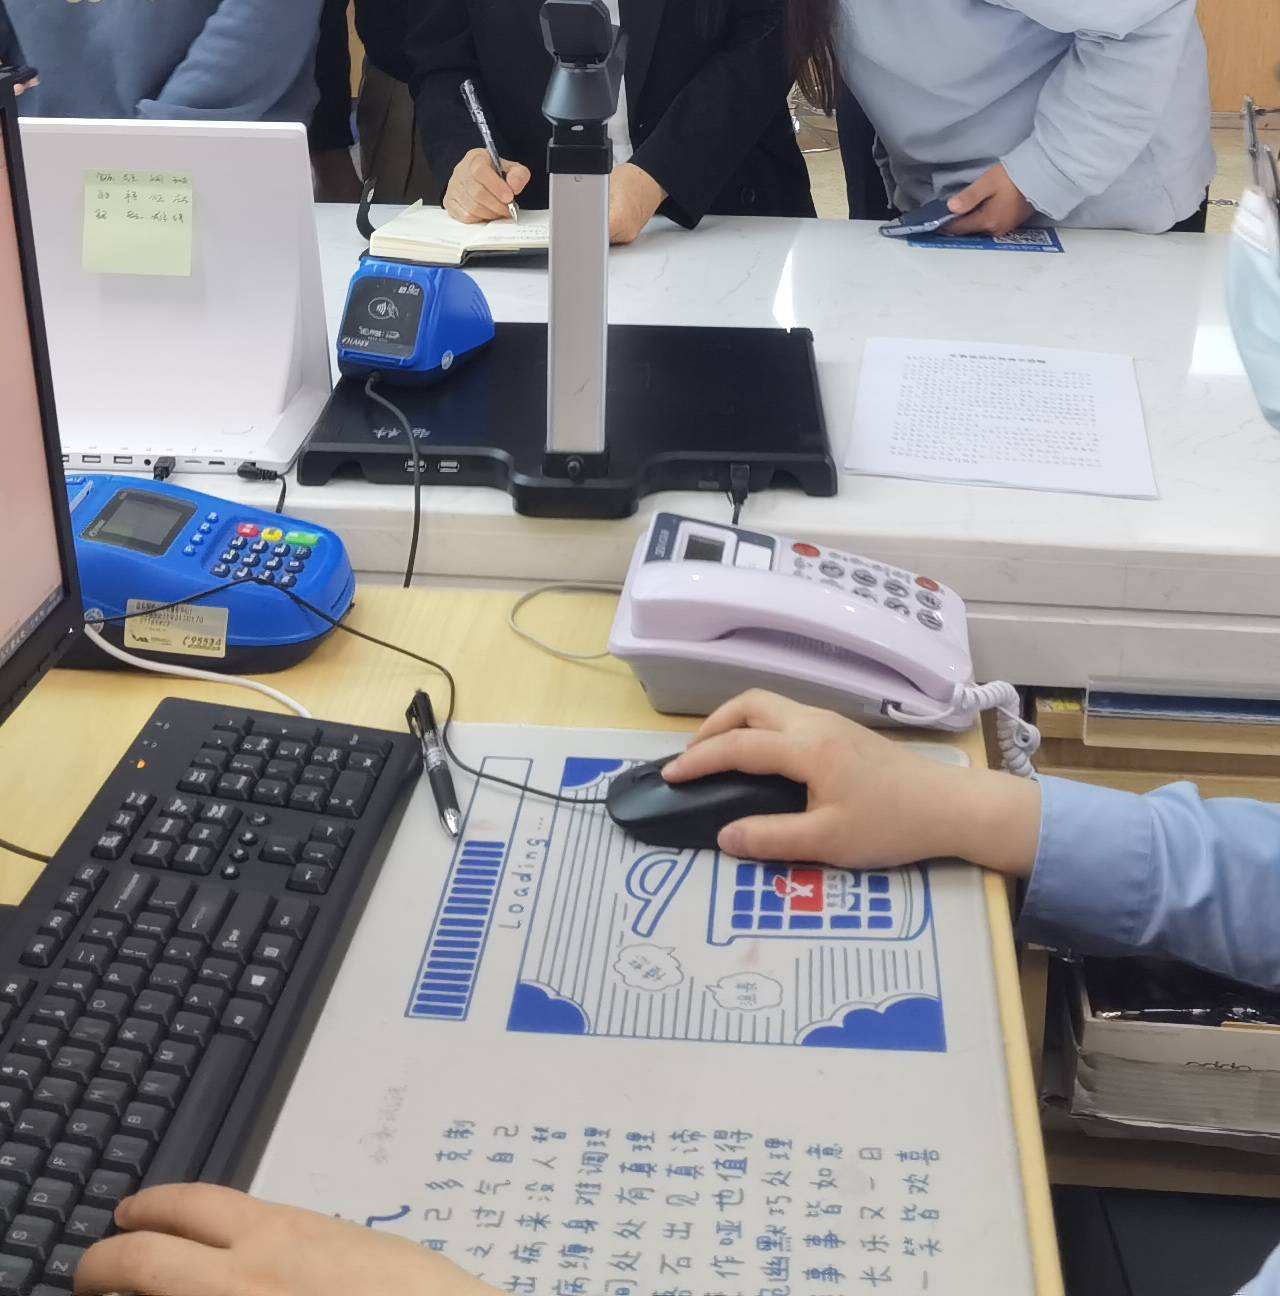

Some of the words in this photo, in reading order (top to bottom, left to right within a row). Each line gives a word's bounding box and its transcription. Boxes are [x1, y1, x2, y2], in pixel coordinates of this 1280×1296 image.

[464, 1124, 520, 1281] 之过气自己
[704, 1128, 754, 1296] 作哑也值得
[858, 1146, 894, 1288] 长乐又一日
[894, 1148, 945, 1292] 一笑皆欢喜
